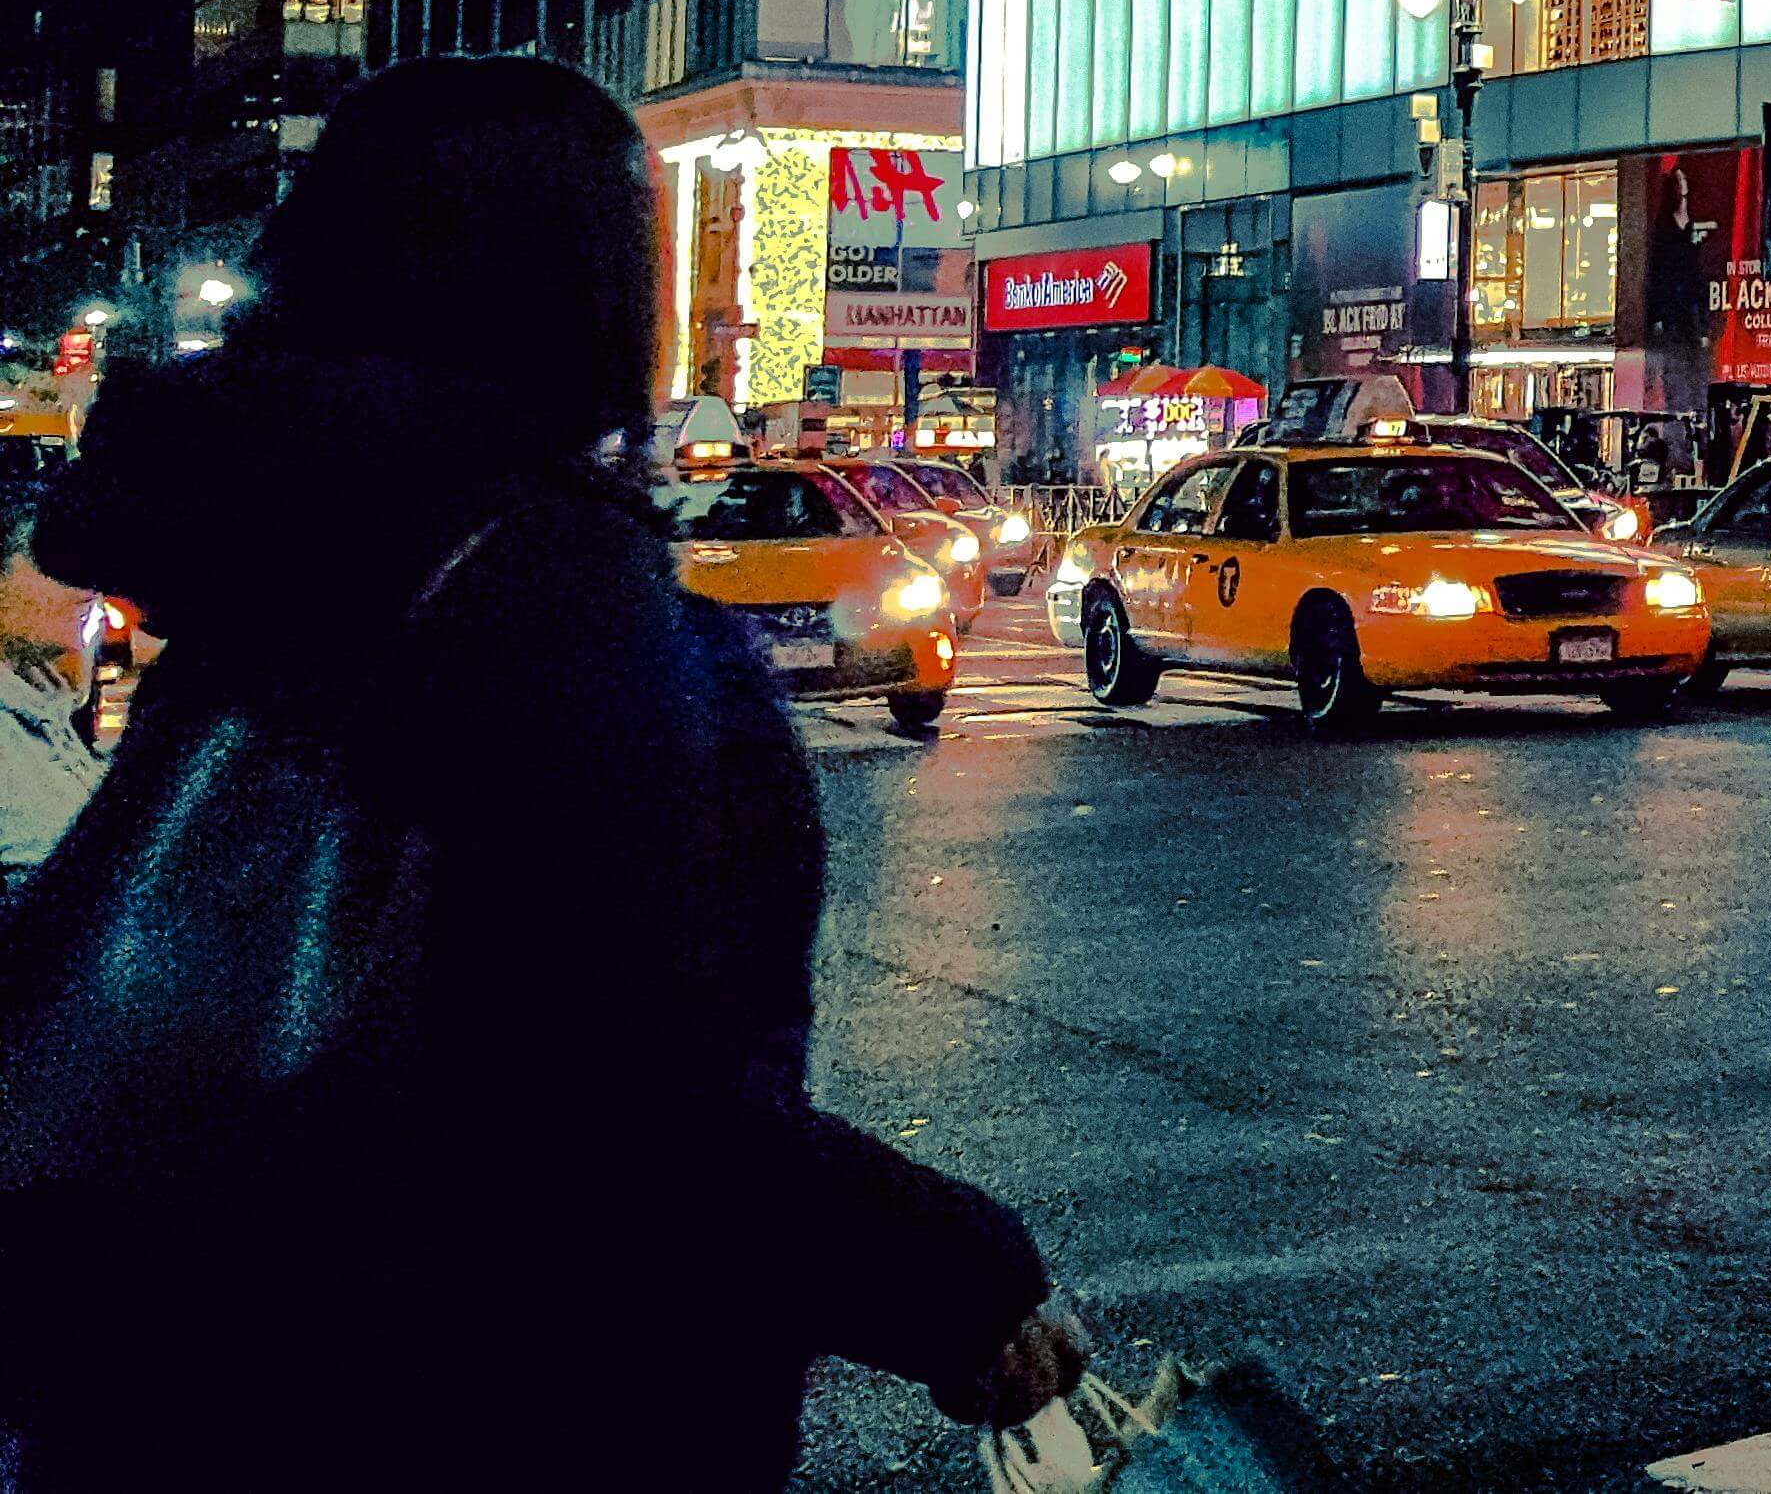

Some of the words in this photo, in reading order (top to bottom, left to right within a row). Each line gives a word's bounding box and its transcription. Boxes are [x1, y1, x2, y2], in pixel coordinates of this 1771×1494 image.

[1005, 273, 1034, 310] Bank
[1044, 270, 1095, 306] America
[846, 305, 967, 328] MANHATTAN
